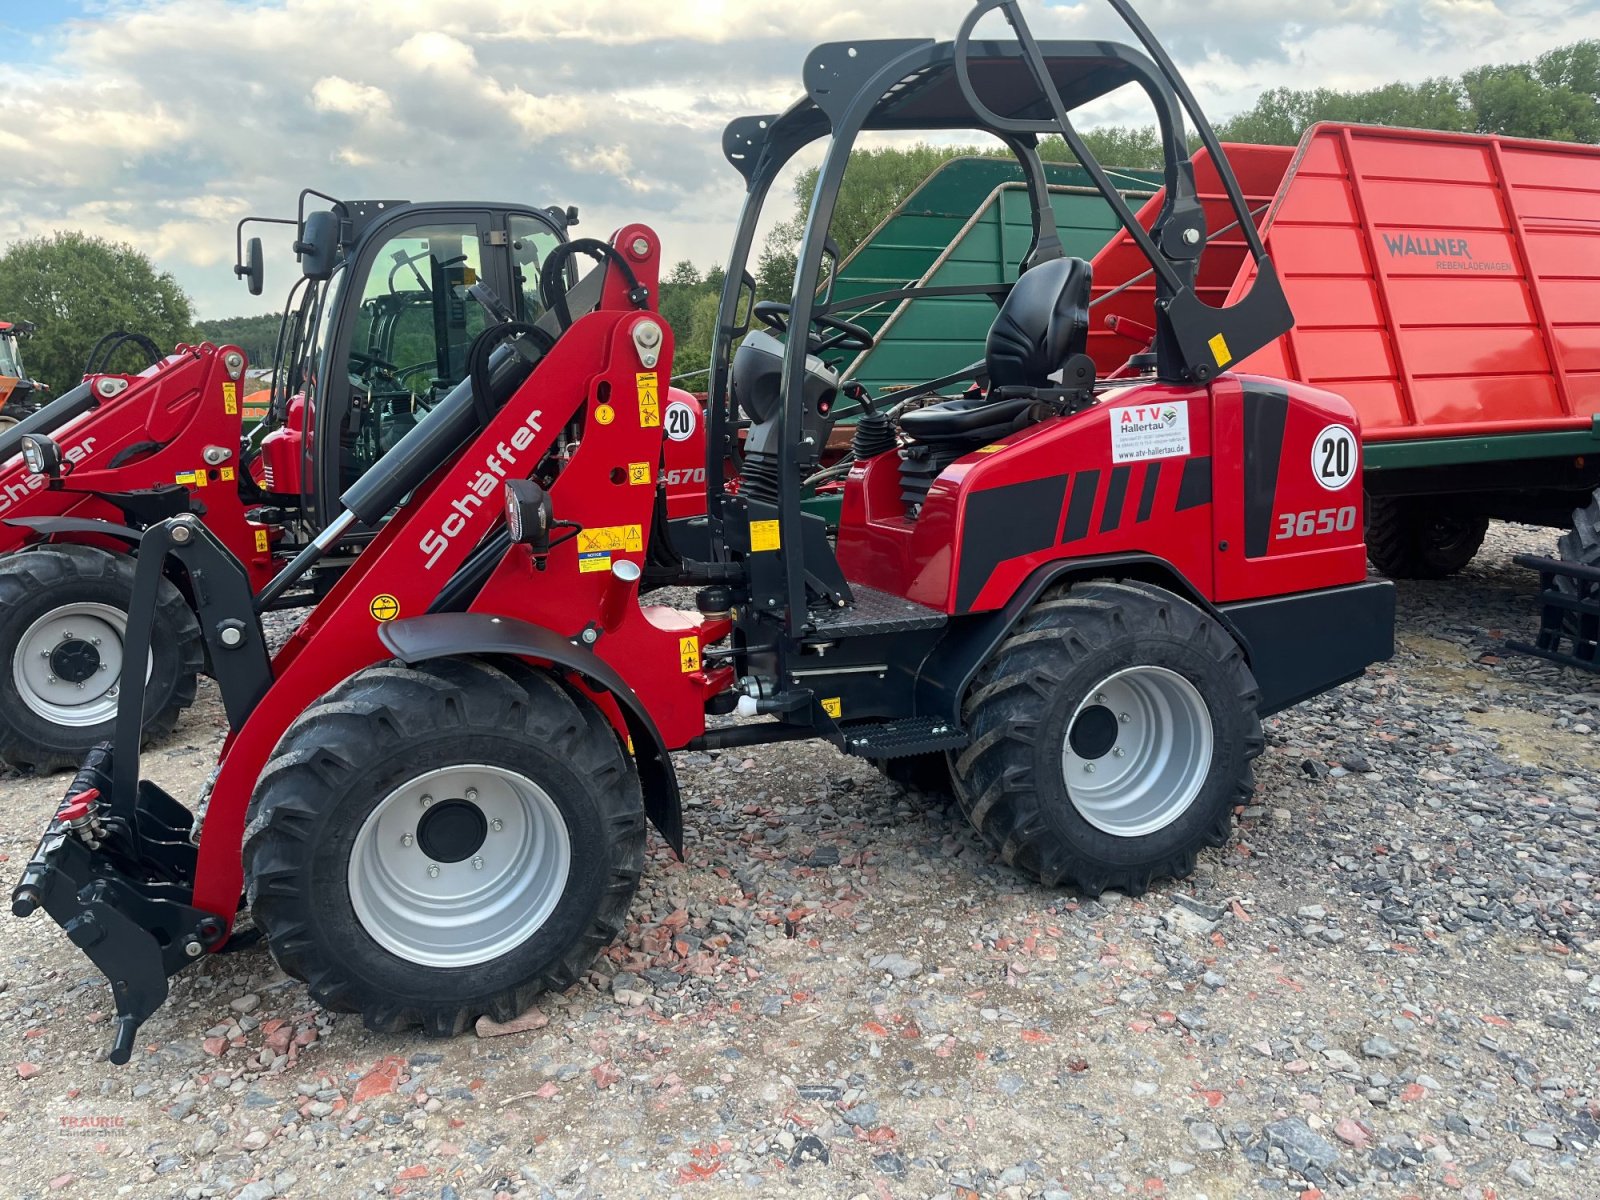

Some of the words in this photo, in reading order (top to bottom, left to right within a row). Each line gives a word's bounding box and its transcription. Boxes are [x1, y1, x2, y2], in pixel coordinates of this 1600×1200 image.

[1382, 233, 1472, 260] WALLNER
[1436, 260, 1512, 271] REBENLADEWAGEN
[669, 409, 690, 434] 20
[1120, 422, 1164, 434] Hallertau
[1118, 444, 1185, 459] www.atv-hallertau.de
[1321, 437, 1350, 478] 20
[666, 467, 706, 486] 670
[419, 409, 543, 570] Schäffer
[1275, 505, 1357, 540] 3650
